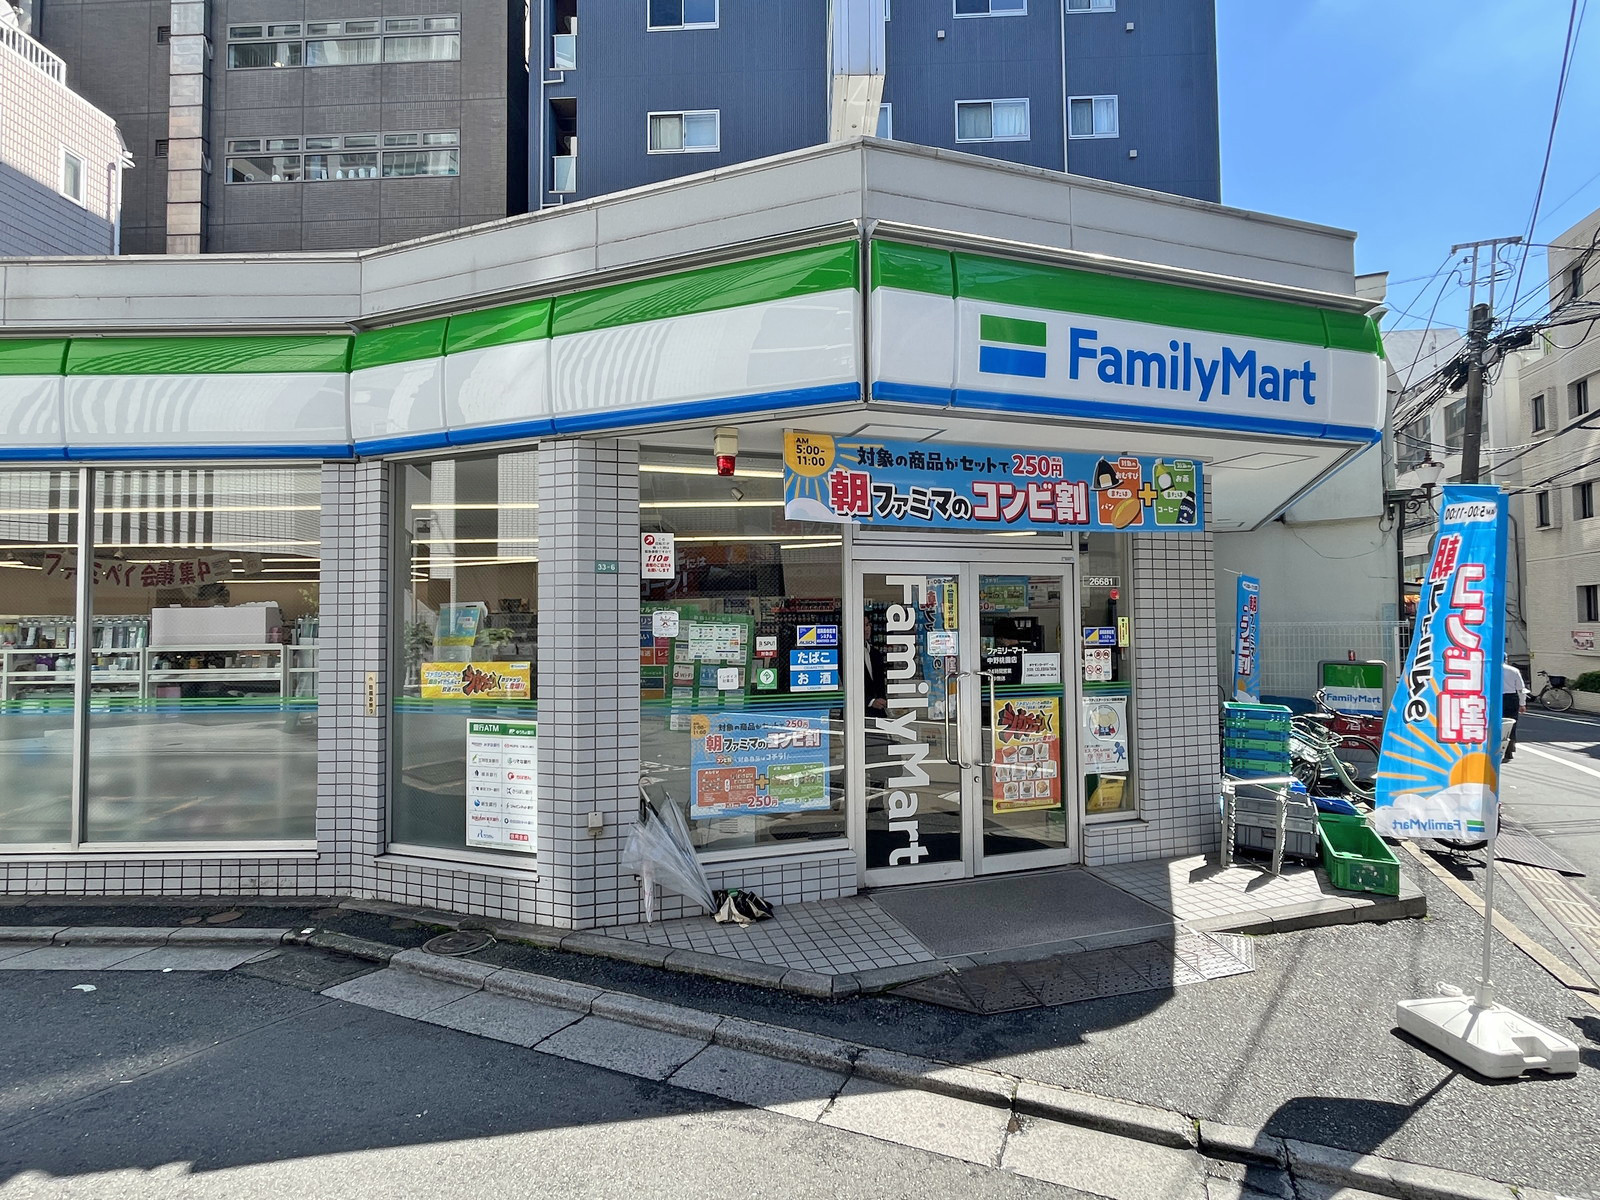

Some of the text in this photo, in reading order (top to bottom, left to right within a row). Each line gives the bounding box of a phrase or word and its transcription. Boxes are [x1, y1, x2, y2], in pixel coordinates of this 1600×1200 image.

[1069, 327, 1316, 405] FamilyMart
[796, 445, 825, 455] 5:00-
[797, 456, 825, 466] 11:00
[1101, 503, 1114, 511] パン
[597, 563, 616, 571] 33-6
[1089, 577, 1114, 586] 26681
[987, 647, 1028, 655] ファミリーマート
[797, 651, 831, 664] たばこ
[1326, 693, 1381, 704] FamilyMart
[876, 575, 930, 866] FamilyMart
[747, 795, 778, 808] 250円
